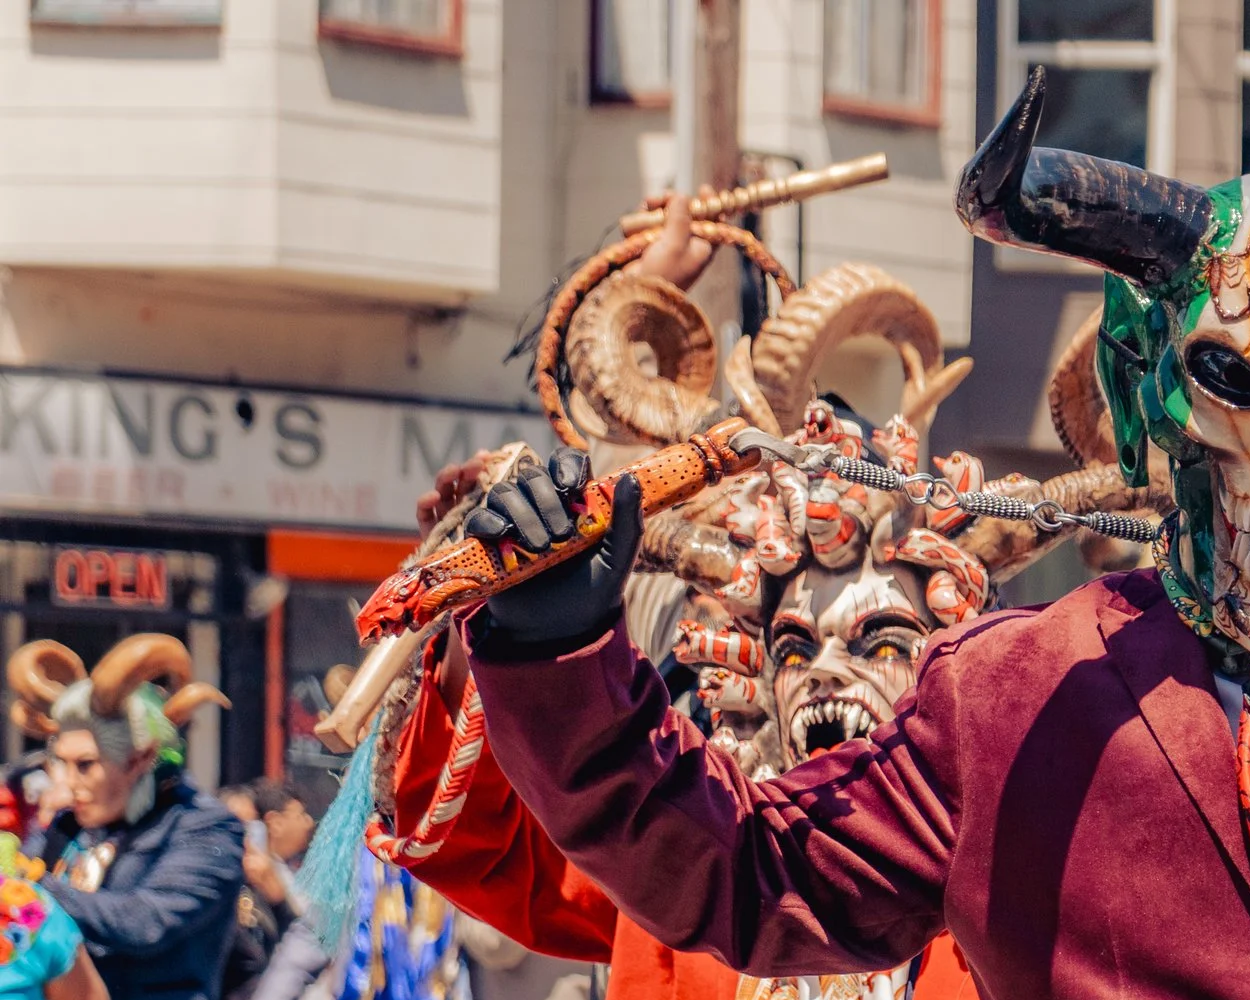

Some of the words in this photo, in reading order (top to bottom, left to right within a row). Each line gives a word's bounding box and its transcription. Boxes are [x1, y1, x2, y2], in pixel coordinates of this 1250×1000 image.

[0, 376, 325, 472] KING'S
[268, 480, 377, 516] WINE
[56, 549, 166, 607] OPEN
